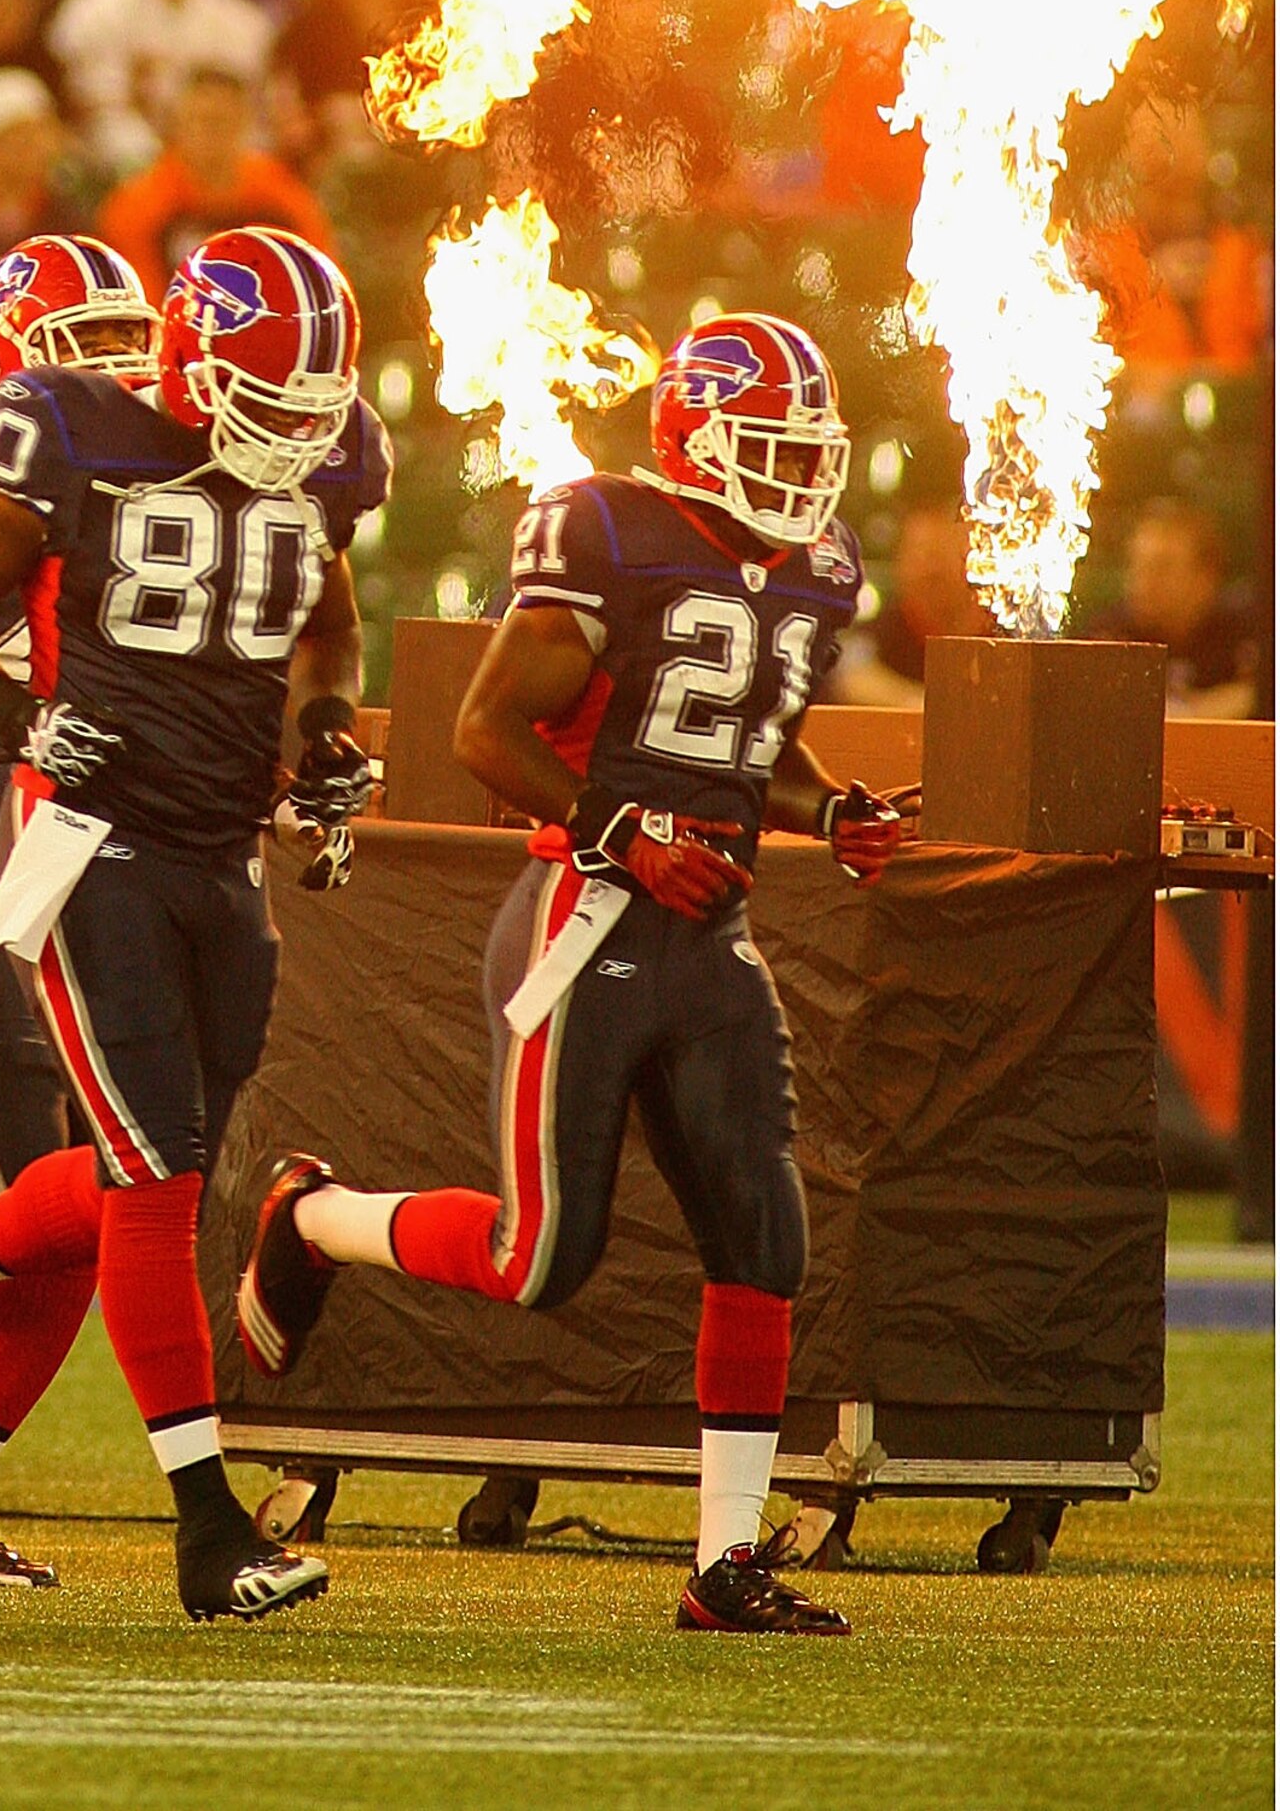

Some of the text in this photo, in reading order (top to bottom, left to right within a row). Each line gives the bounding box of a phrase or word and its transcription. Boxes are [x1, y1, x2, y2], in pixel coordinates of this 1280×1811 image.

[97, 481, 328, 661] 80
[511, 503, 571, 575] 21
[633, 588, 819, 778] 21
